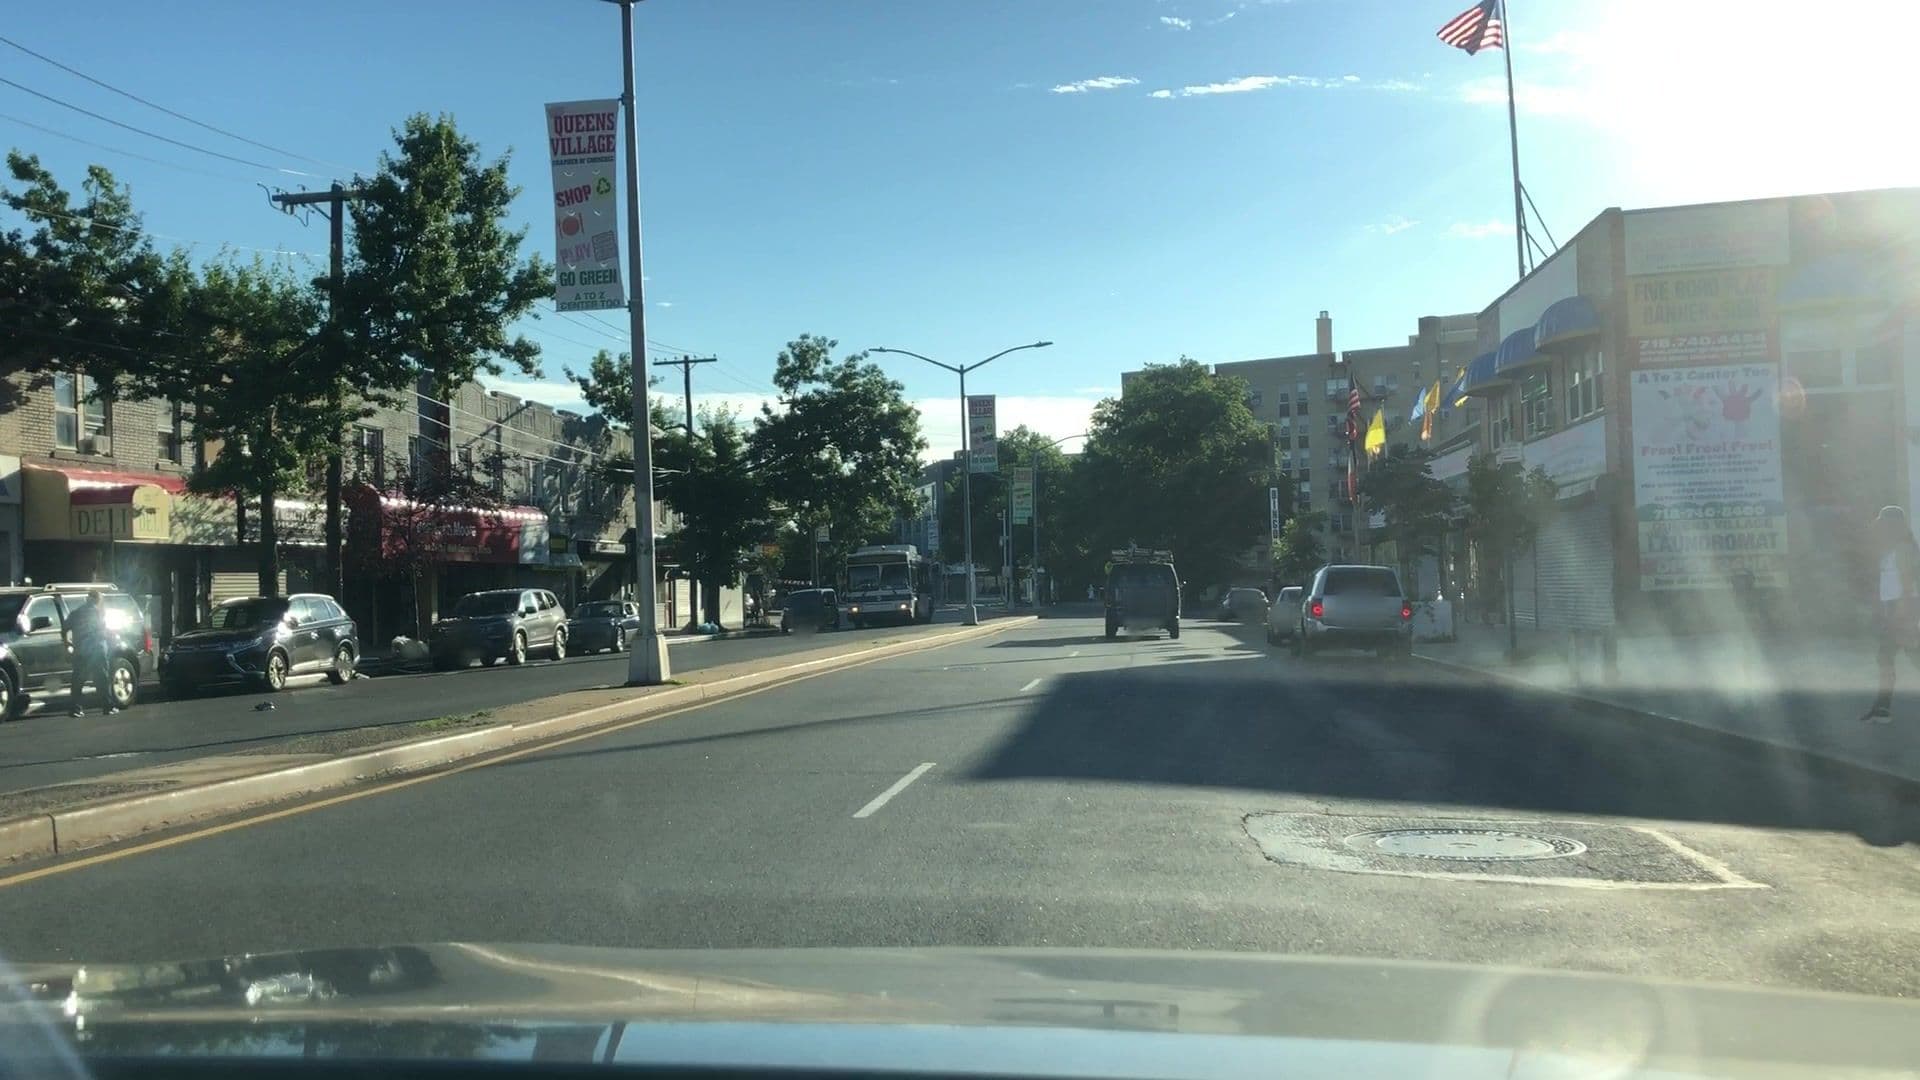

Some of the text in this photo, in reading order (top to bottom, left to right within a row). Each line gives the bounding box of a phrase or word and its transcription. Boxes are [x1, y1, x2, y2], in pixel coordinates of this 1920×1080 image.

[553, 112, 615, 136] QUEENS
[550, 134, 616, 157] VILLAGE
[556, 184, 592, 208] SHOP
[559, 242, 592, 265] PLAY
[559, 269, 617, 287] GO GREEN
[574, 291, 606, 301] A TO Z
[1639, 373, 1649, 384] A
[78, 508, 128, 536] DELI
[1648, 532, 1778, 553] LAUNDROMAT
